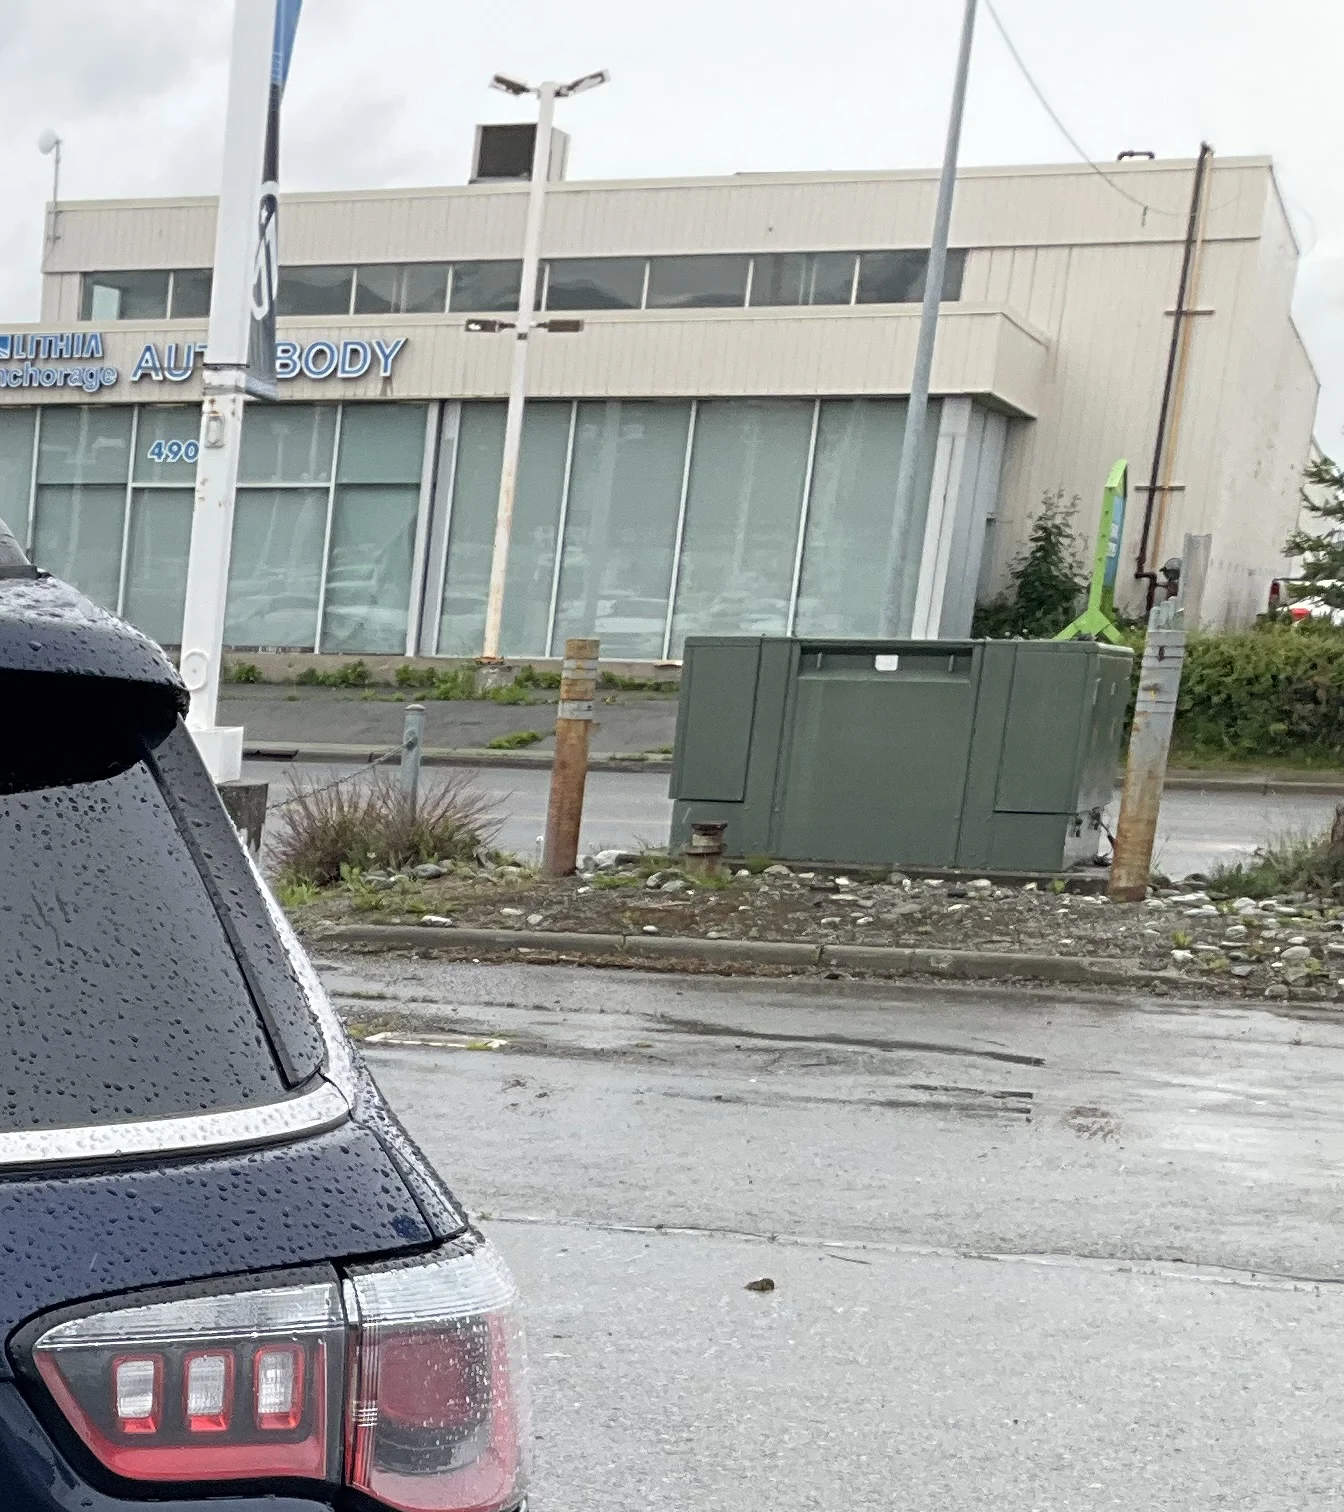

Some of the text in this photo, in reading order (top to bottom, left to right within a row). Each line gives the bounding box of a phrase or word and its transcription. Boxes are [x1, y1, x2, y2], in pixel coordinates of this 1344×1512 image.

[13, 332, 103, 359] LITHIA
[130, 337, 409, 382] AU BODY
